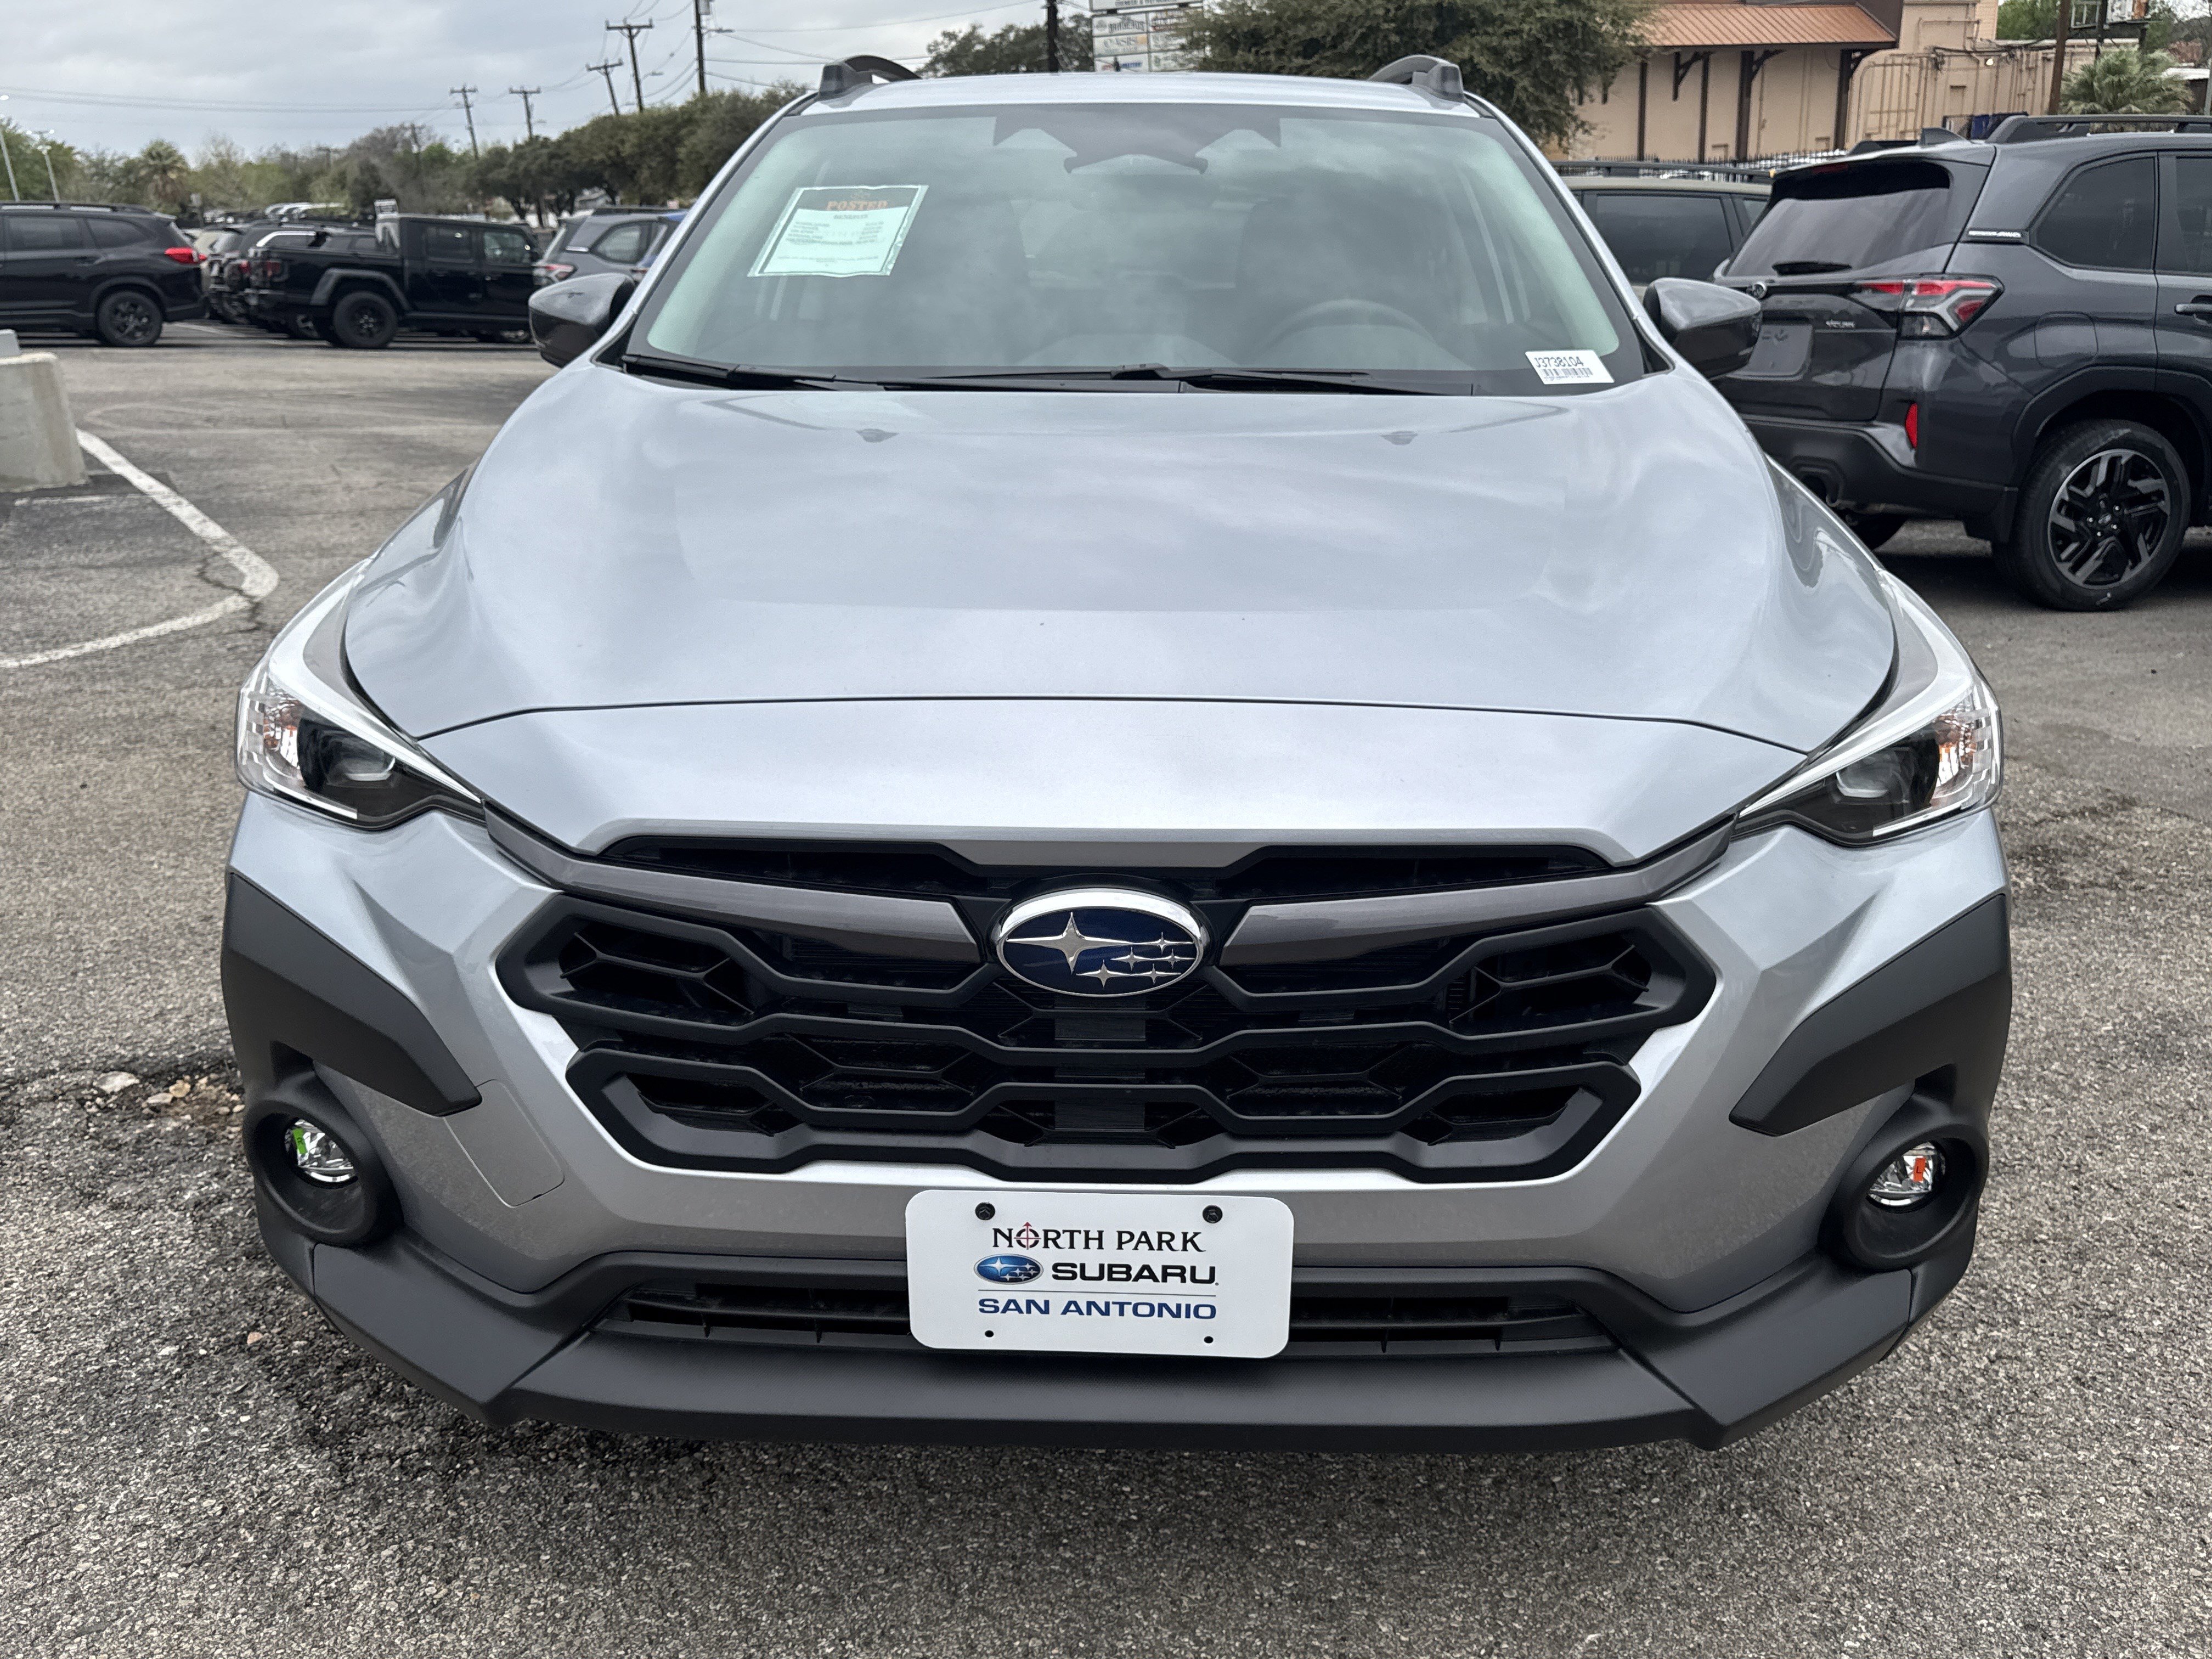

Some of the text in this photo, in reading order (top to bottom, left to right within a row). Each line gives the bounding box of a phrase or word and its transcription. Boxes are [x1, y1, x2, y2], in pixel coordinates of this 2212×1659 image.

[1534, 356, 1584, 368] J3738104
[1916, 1165, 1922, 1174] L
[992, 1227, 1205, 1252] NORTH PARK
[1052, 1263, 1216, 1284] SUBARU
[979, 1299, 1216, 1319] SAN ANTONIO
